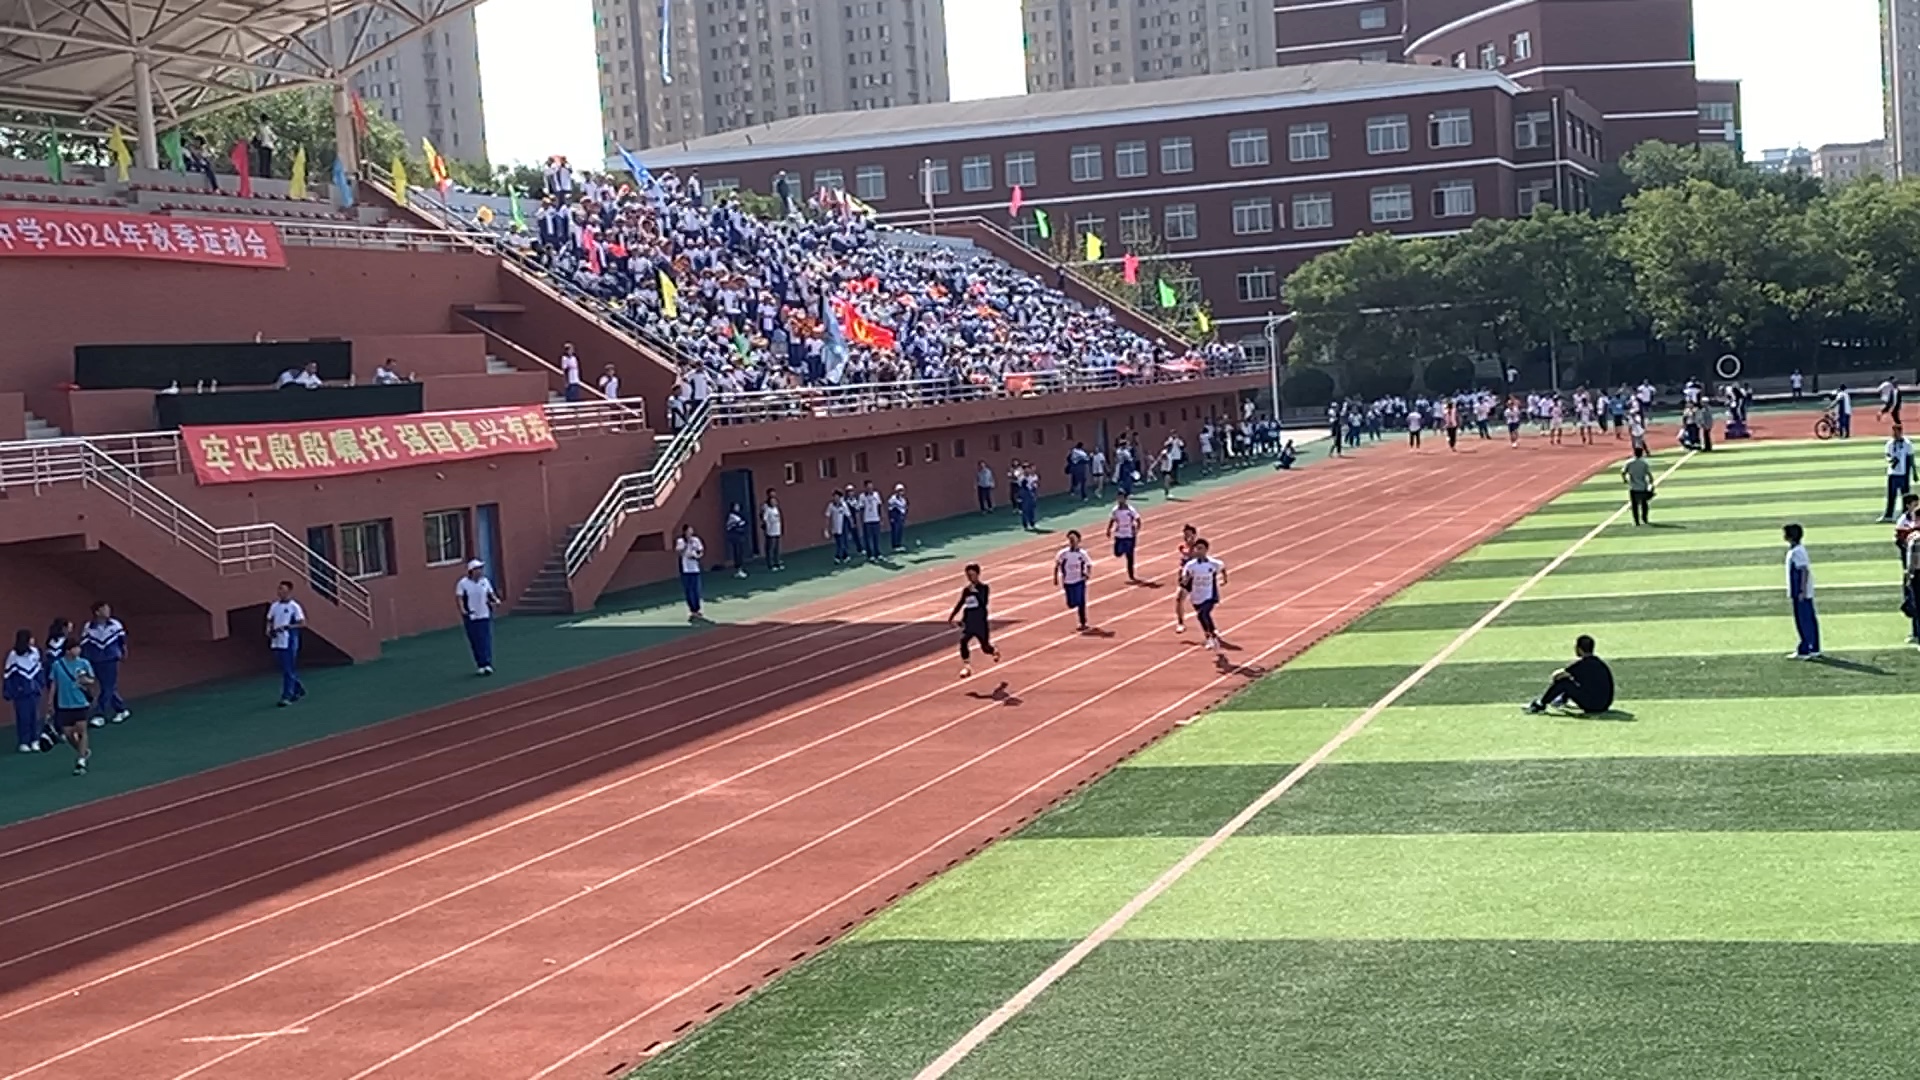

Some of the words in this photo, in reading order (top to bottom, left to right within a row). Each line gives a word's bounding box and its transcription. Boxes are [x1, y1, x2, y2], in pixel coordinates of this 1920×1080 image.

[200, 425, 398, 475] 牢记殷殷嘱托
[393, 412, 554, 456] 强国复兴有我
